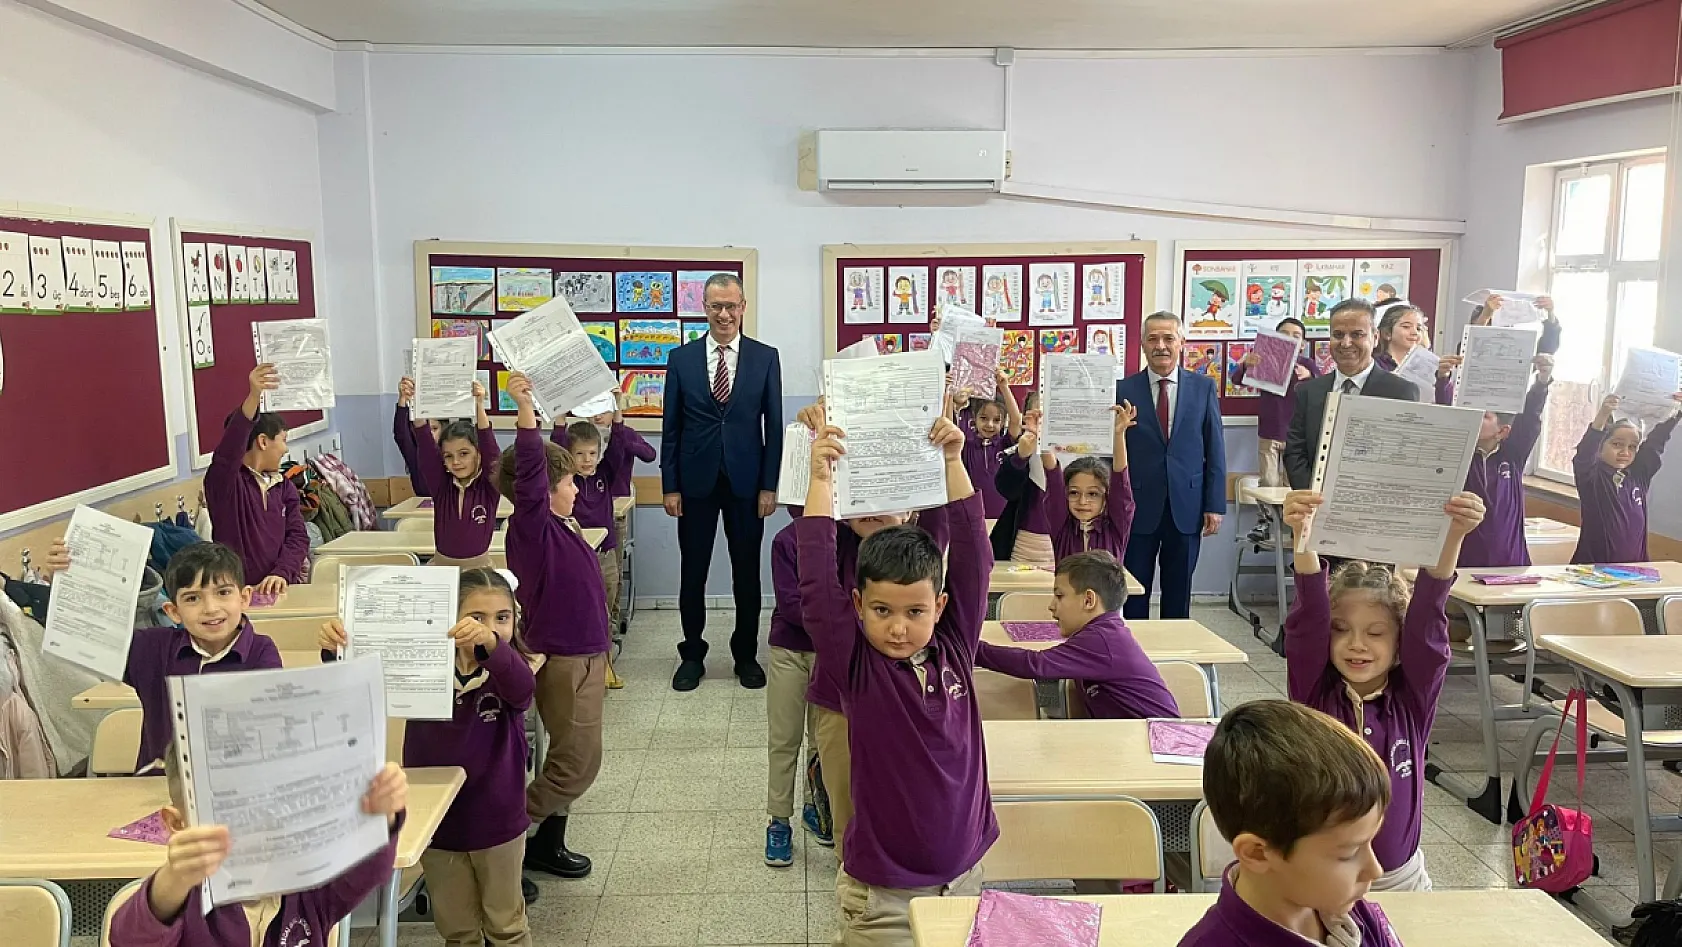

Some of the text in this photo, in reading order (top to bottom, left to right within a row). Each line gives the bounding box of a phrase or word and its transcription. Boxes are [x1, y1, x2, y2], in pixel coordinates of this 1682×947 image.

[3, 270, 14, 297] 2
[37, 273, 47, 299] 3
[68, 271, 79, 297] 4
[98, 275, 107, 298] 5
[128, 274, 138, 298] 6
[192, 277, 200, 292] A
[214, 275, 222, 292] N
[235, 276, 240, 292] E
[253, 277, 258, 292] T
[286, 278, 291, 294] L
[197, 340, 205, 355] O
